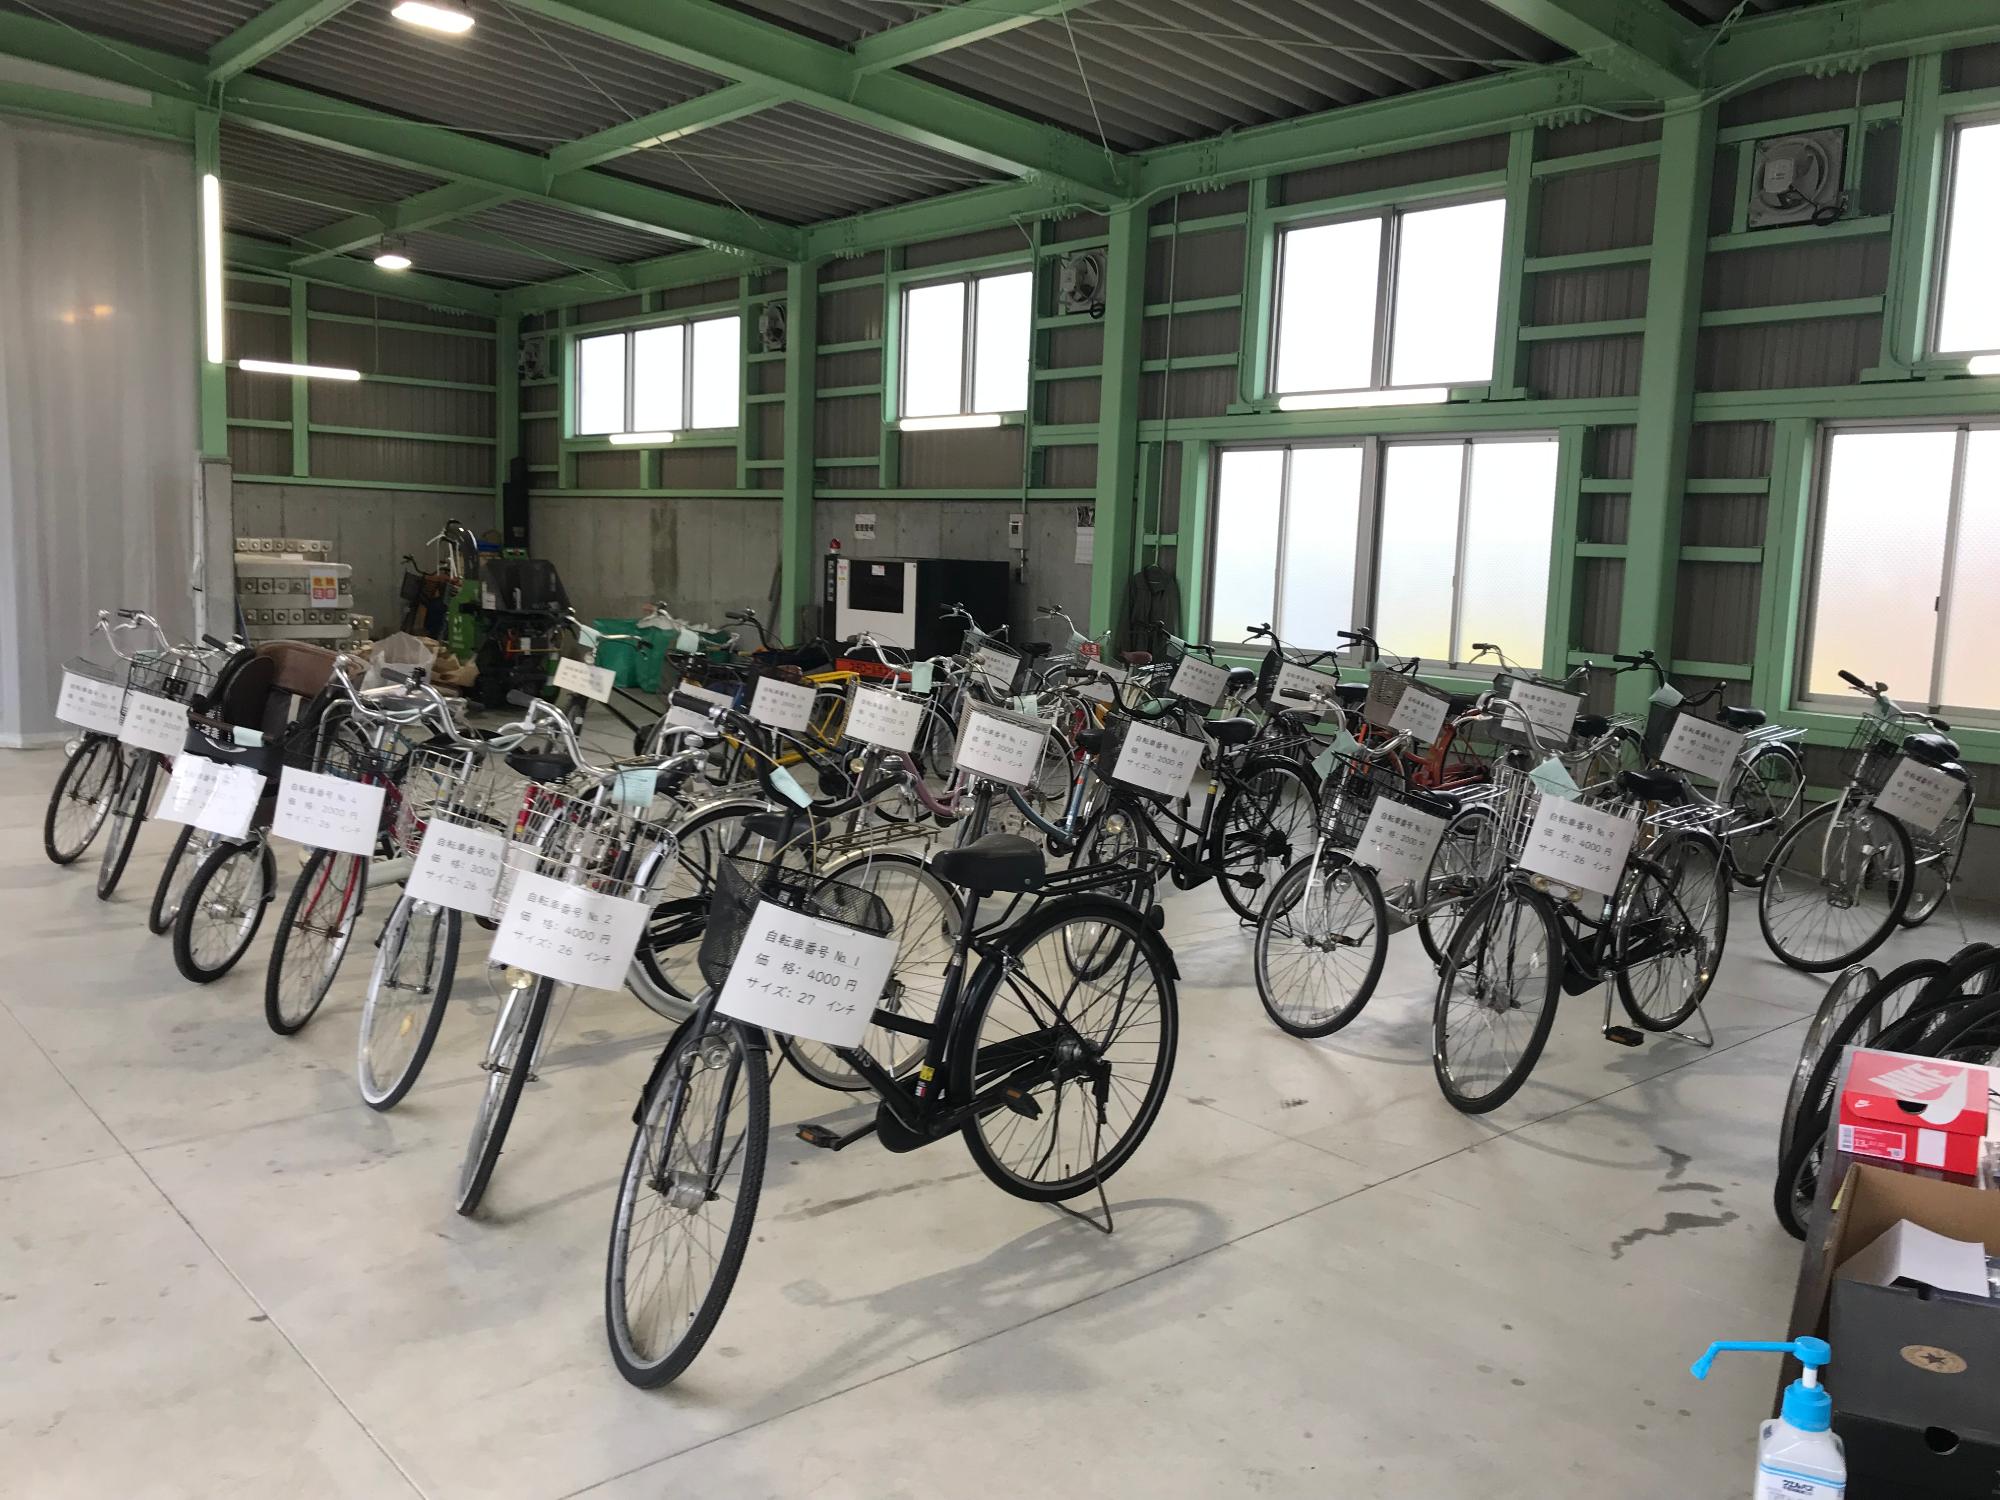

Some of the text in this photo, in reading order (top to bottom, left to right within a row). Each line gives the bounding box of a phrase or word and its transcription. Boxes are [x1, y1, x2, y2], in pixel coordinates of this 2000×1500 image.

[1579, 840, 1601, 853] 4000
[1574, 855, 1585, 864] 26
[528, 892, 583, 917] 自転車番号
[604, 915, 613, 924] 2
[564, 928, 595, 941] 4000
[765, 930, 829, 958] 自転車番号
[558, 945, 573, 956] 26
[584, 951, 611, 965] インチ
[807, 970, 840, 986] 4000
[797, 993, 816, 1005] 27
[826, 1000, 855, 1015] インチ
